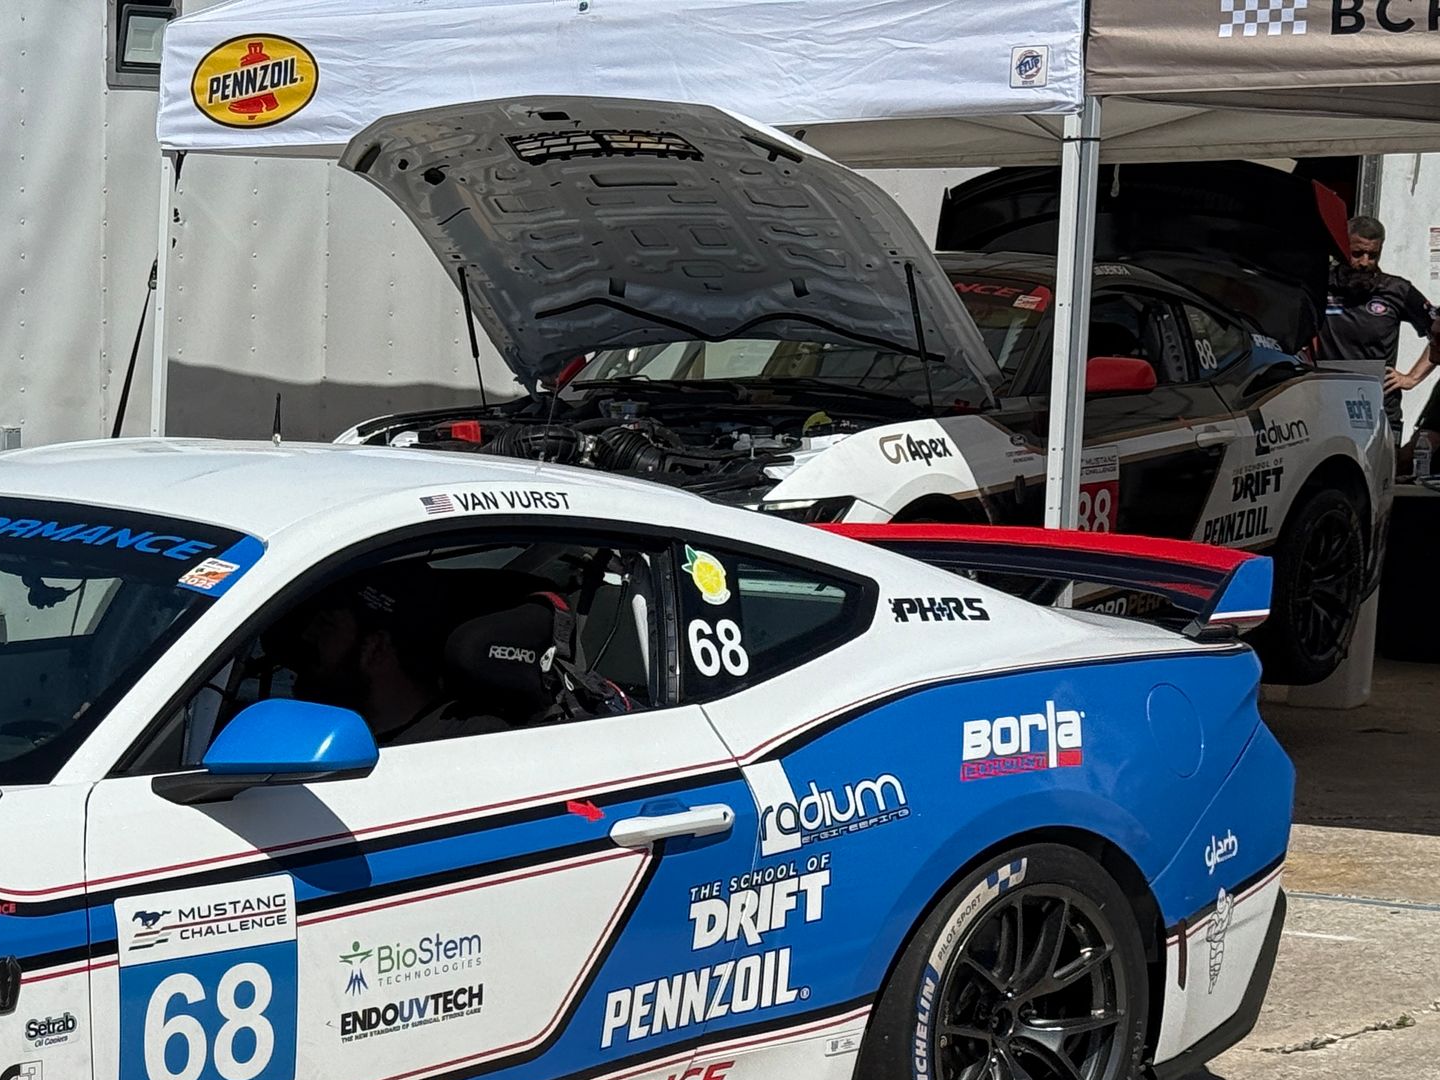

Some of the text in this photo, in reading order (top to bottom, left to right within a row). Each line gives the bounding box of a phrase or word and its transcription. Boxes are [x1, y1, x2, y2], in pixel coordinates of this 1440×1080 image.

[1331, 0, 1440, 35] BC
[208, 57, 303, 104] PENNZOIL
[1195, 340, 1217, 370] 88
[905, 434, 953, 466] Apex
[453, 490, 570, 512] VAN VURST
[1232, 466, 1284, 502] DRIFT
[1203, 506, 1270, 544] PENNZOIL
[488, 645, 536, 664] RECARO
[688, 619, 749, 677] 68
[690, 853, 831, 901] THE SCHOOL OF
[178, 893, 287, 922] MUSTANG
[689, 869, 831, 950] DRIFT
[180, 914, 288, 940] CHALLENGE
[937, 893, 982, 961] PILOT SPORT
[378, 932, 482, 974] BioStem
[378, 957, 482, 987] TECHNOLOGIES
[340, 983, 484, 1036] ENDOUVTECH
[600, 947, 800, 1049] PENNZOIL
[26, 1013, 77, 1040] Setrab
[341, 1035, 354, 1044] THE
[369, 1025, 401, 1037] STANDARD
